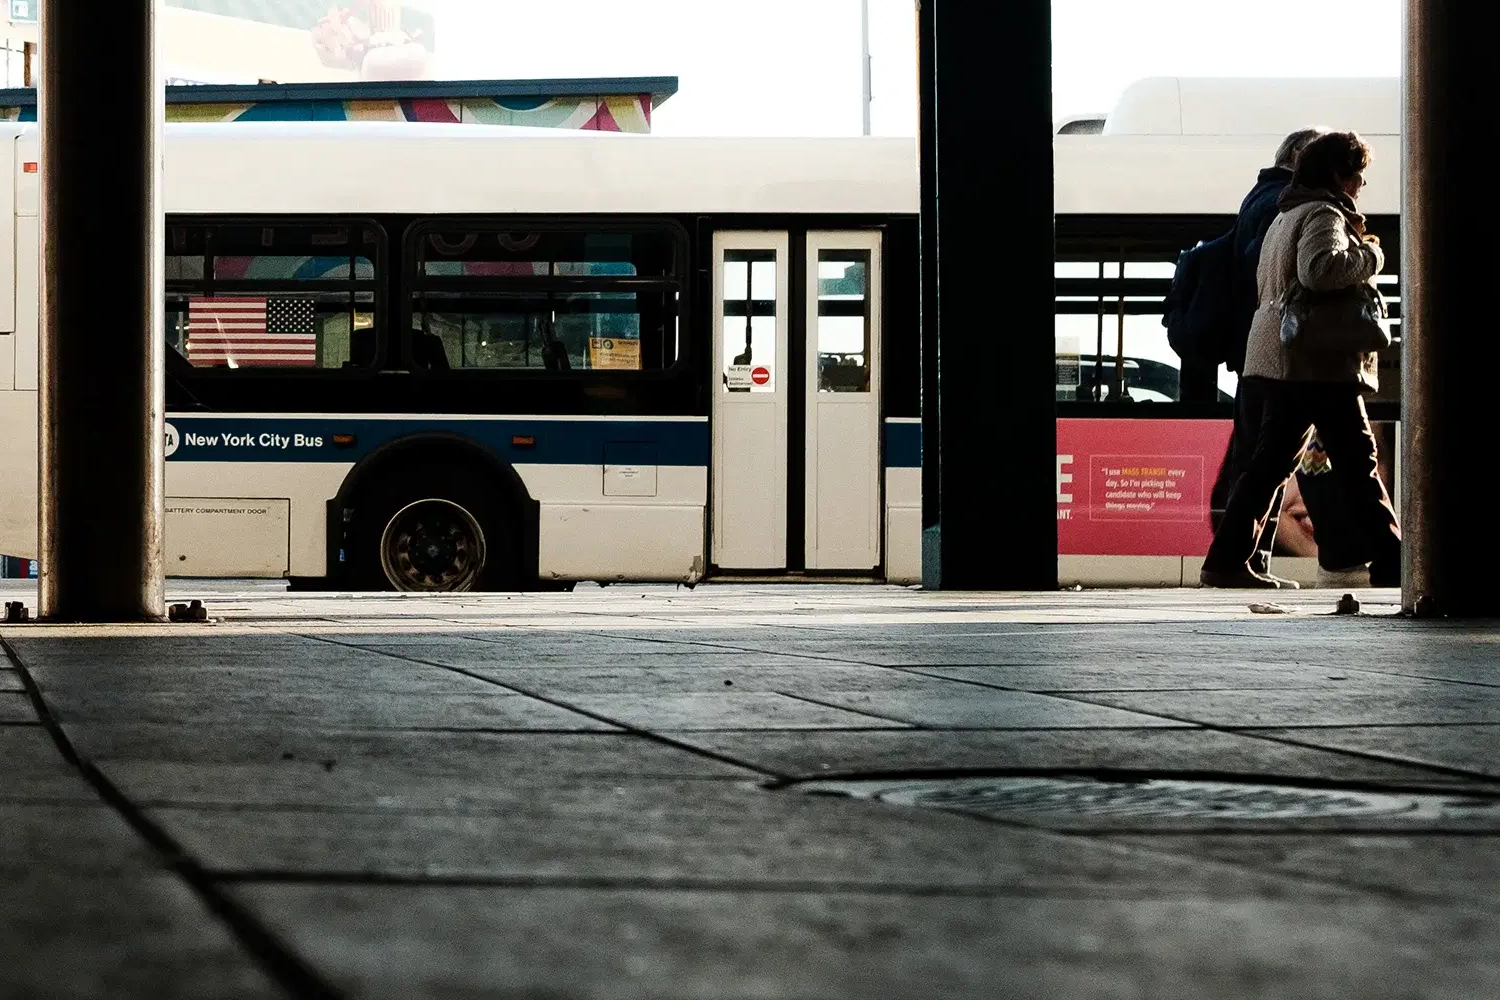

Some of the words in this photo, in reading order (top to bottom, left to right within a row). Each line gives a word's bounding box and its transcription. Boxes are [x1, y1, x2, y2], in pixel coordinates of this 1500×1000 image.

[185, 433, 218, 446] New
[221, 433, 255, 447] York
[259, 434, 290, 449] City
[294, 434, 323, 447] Bus
[1122, 468, 1139, 476] MASS
[1141, 467, 1167, 476] TRANSIT
[1167, 469, 1185, 478] every
[1105, 479, 1119, 488] day.
[1120, 479, 1129, 487] So
[1129, 479, 1140, 487] I'm
[1141, 479, 1164, 489] picking
[1165, 479, 1176, 487] the
[1105, 490, 1137, 499] candidate
[1138, 490, 1152, 499] who
[1153, 490, 1165, 499] will
[1165, 490, 1182, 500] keep
